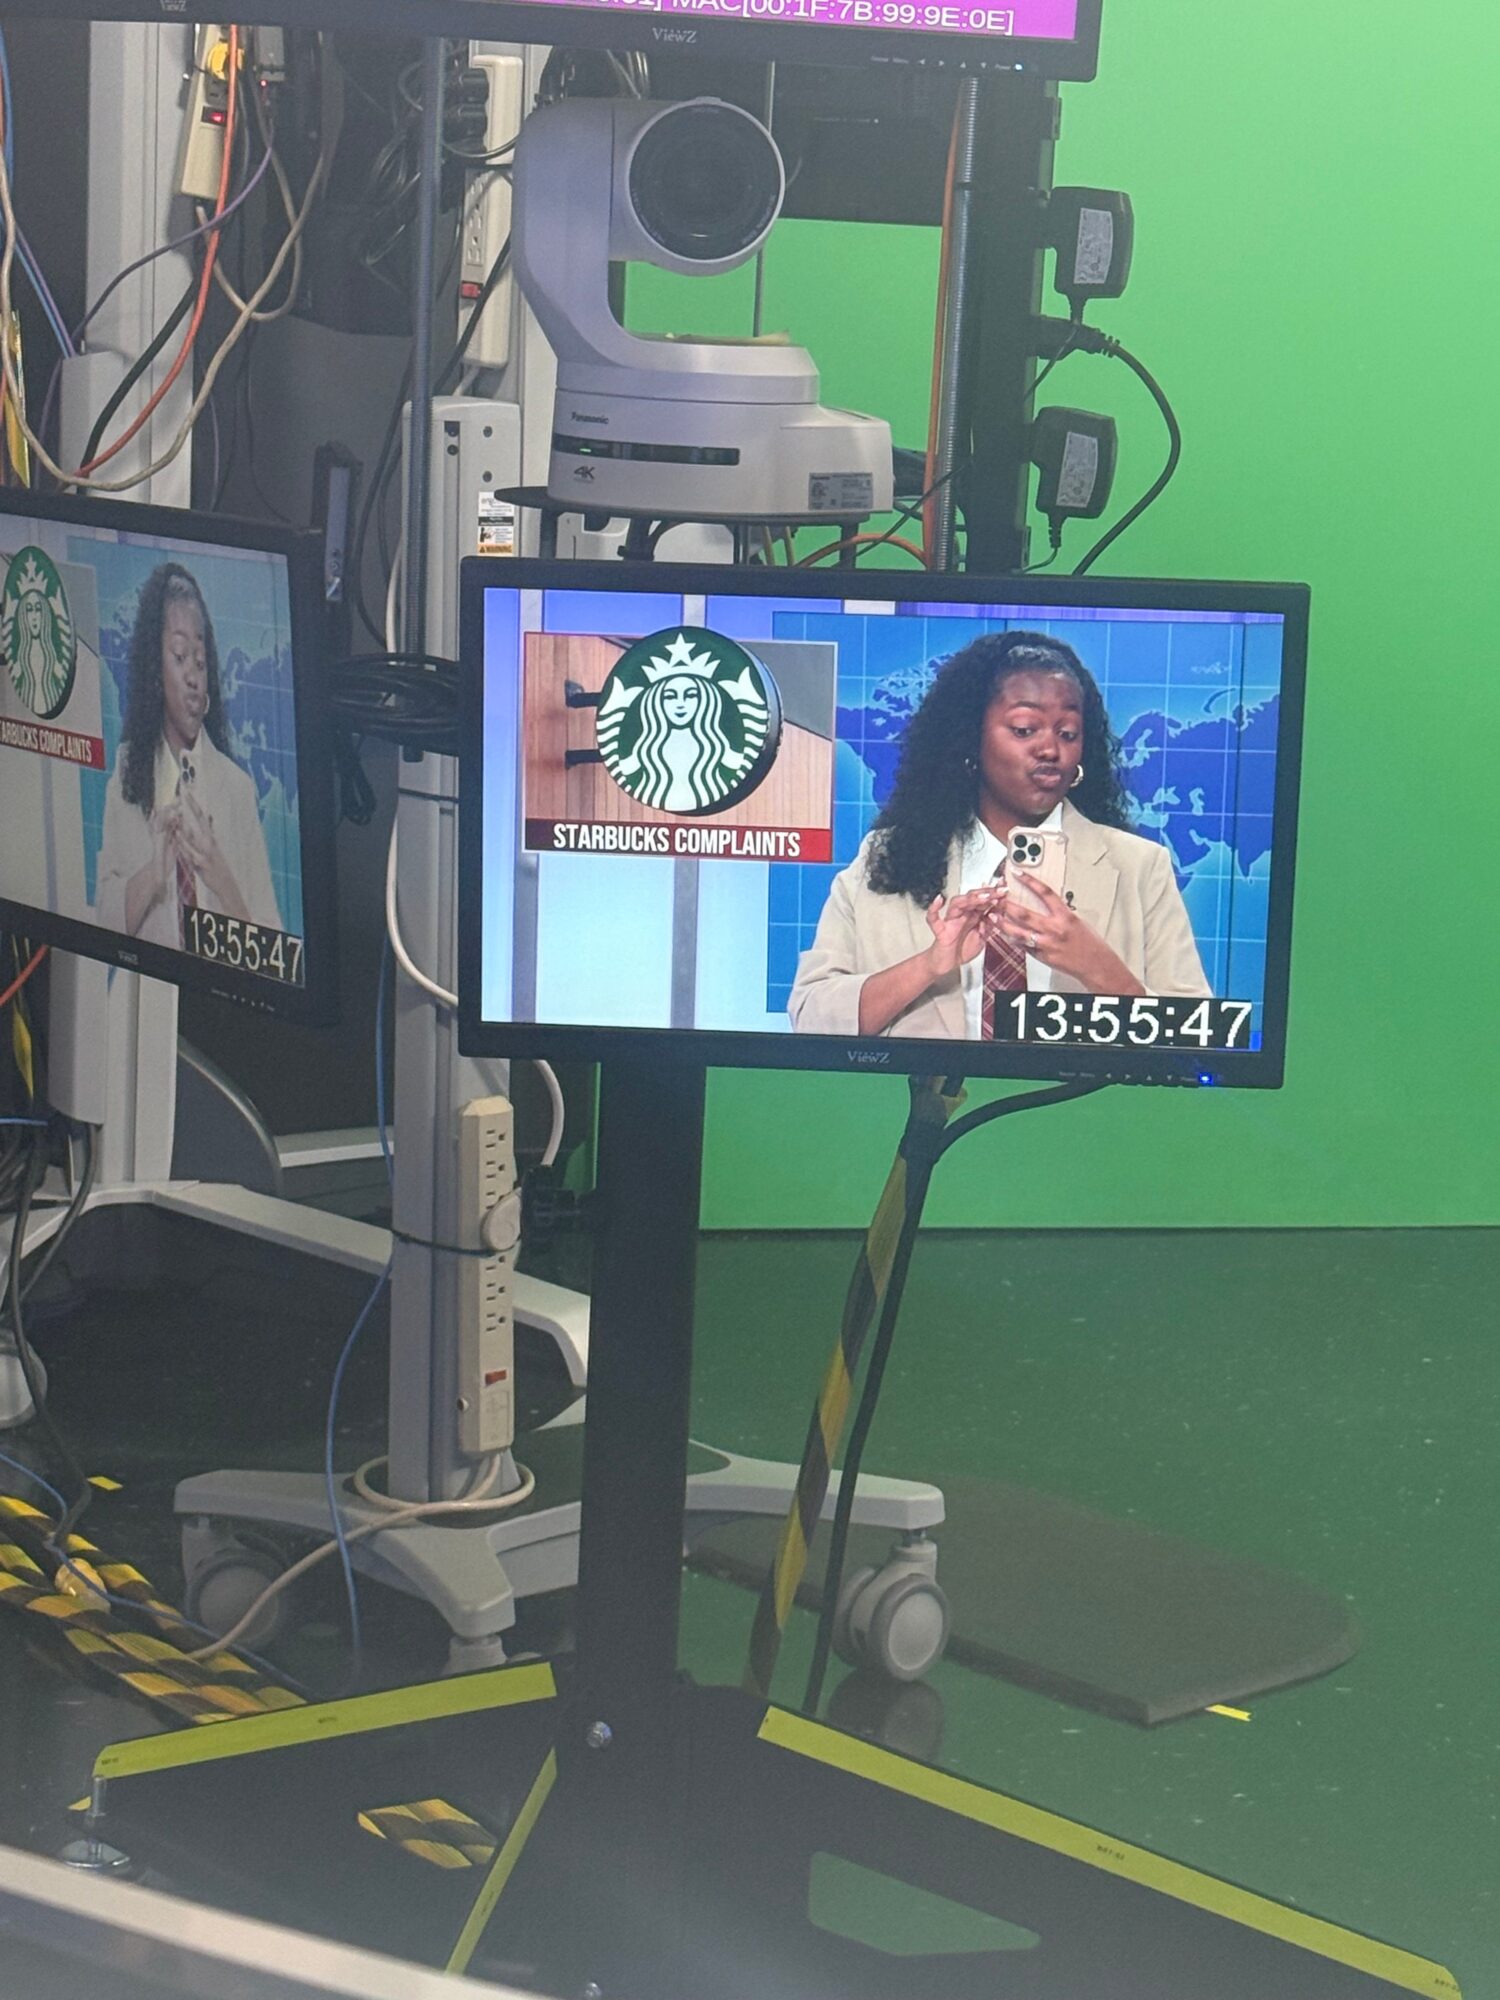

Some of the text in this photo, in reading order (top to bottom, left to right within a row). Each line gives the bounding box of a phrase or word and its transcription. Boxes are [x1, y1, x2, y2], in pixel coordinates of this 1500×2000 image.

[652, 27, 697, 44] ViewZ
[574, 465, 595, 480] 4K
[0, 720, 92, 763] ARBUCKS COMPLAINTS
[553, 823, 801, 857] STARBUCKS COMPLAINTS
[191, 909, 302, 983] 13:55:47
[1010, 993, 1253, 1048] 13:55:47
[847, 1050, 890, 1064] ViewZ
